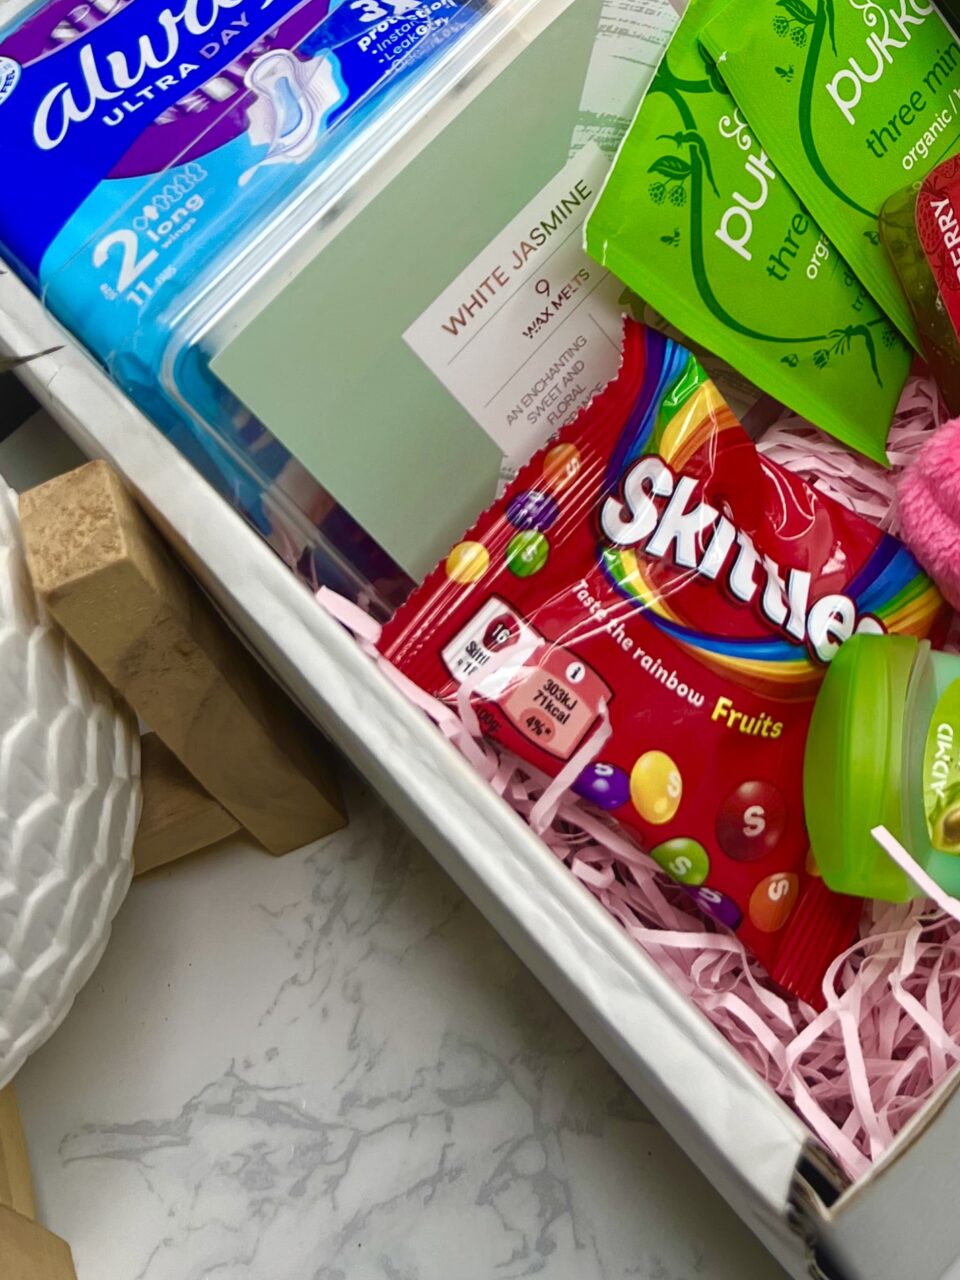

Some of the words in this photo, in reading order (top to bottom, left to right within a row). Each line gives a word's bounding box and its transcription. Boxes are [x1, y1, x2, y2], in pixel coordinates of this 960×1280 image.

[102, 61, 200, 127] ULTRA
[199, 12, 251, 60] DAY
[865, 90, 926, 160] three
[901, 109, 954, 171] organic
[147, 194, 205, 242] long
[93, 228, 160, 294] 2
[441, 265, 510, 337] WHITE
[511, 179, 592, 271] JASMINE
[534, 278, 551, 297] 9
[522, 307, 553, 339] WAX
[552, 268, 590, 310] MELTS
[505, 408, 523, 426] AN
[521, 335, 588, 412] ENCHANTING
[526, 391, 561, 425] SWEET
[560, 359, 586, 390] AND
[546, 383, 587, 426] FLORAL
[601, 456, 888, 664] Skittle
[489, 622, 511, 646] 16
[572, 578, 608, 619] Taste
[605, 614, 631, 652] the
[631, 636, 706, 708] rainbow
[531, 687, 569, 728] 71kcal
[542, 676, 577, 713] 303kJ
[711, 696, 784, 741] Fruits
[742, 805, 765, 837] S
